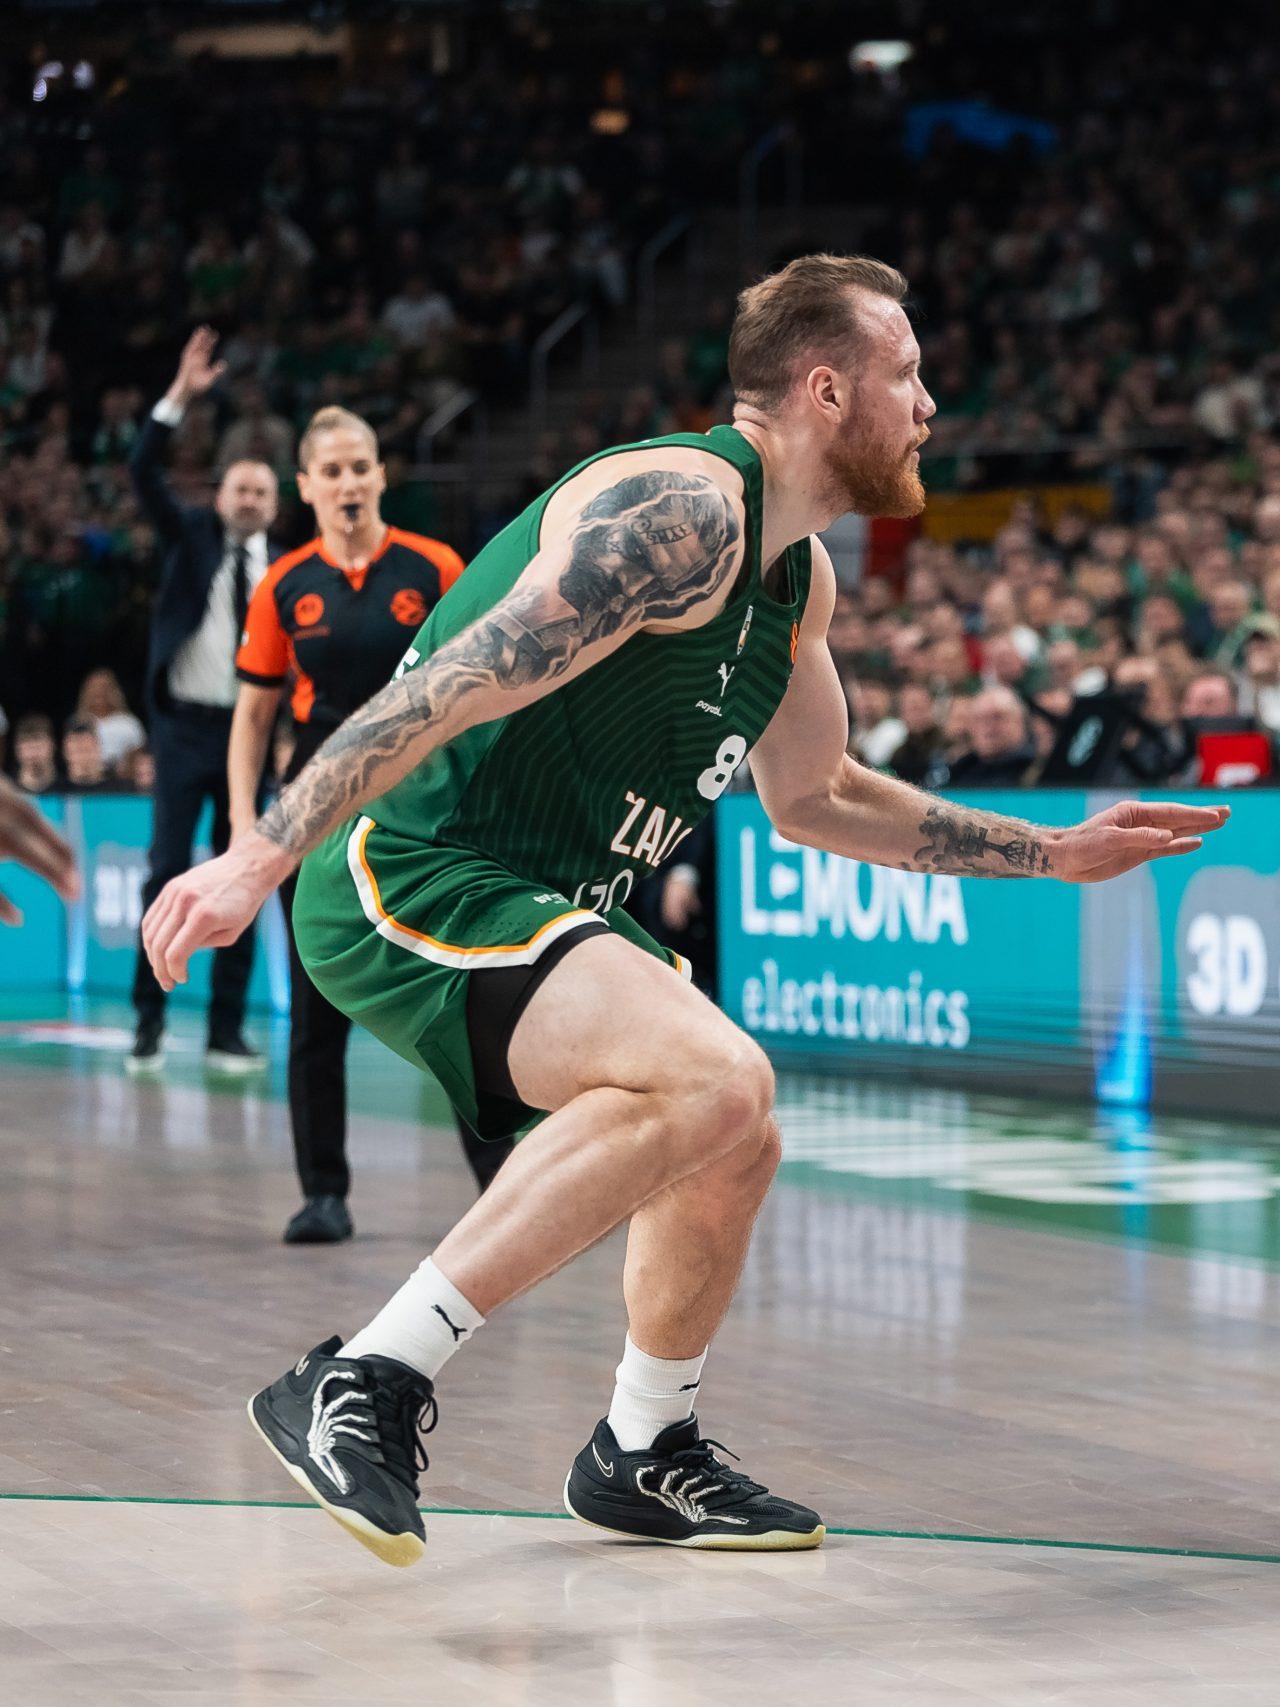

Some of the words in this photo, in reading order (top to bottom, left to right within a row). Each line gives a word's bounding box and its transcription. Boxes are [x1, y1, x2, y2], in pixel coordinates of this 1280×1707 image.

[696, 734, 747, 801] 8
[739, 826, 969, 946] LEMONA
[742, 957, 971, 1049] electronics
[1187, 913, 1268, 1017] 3D
